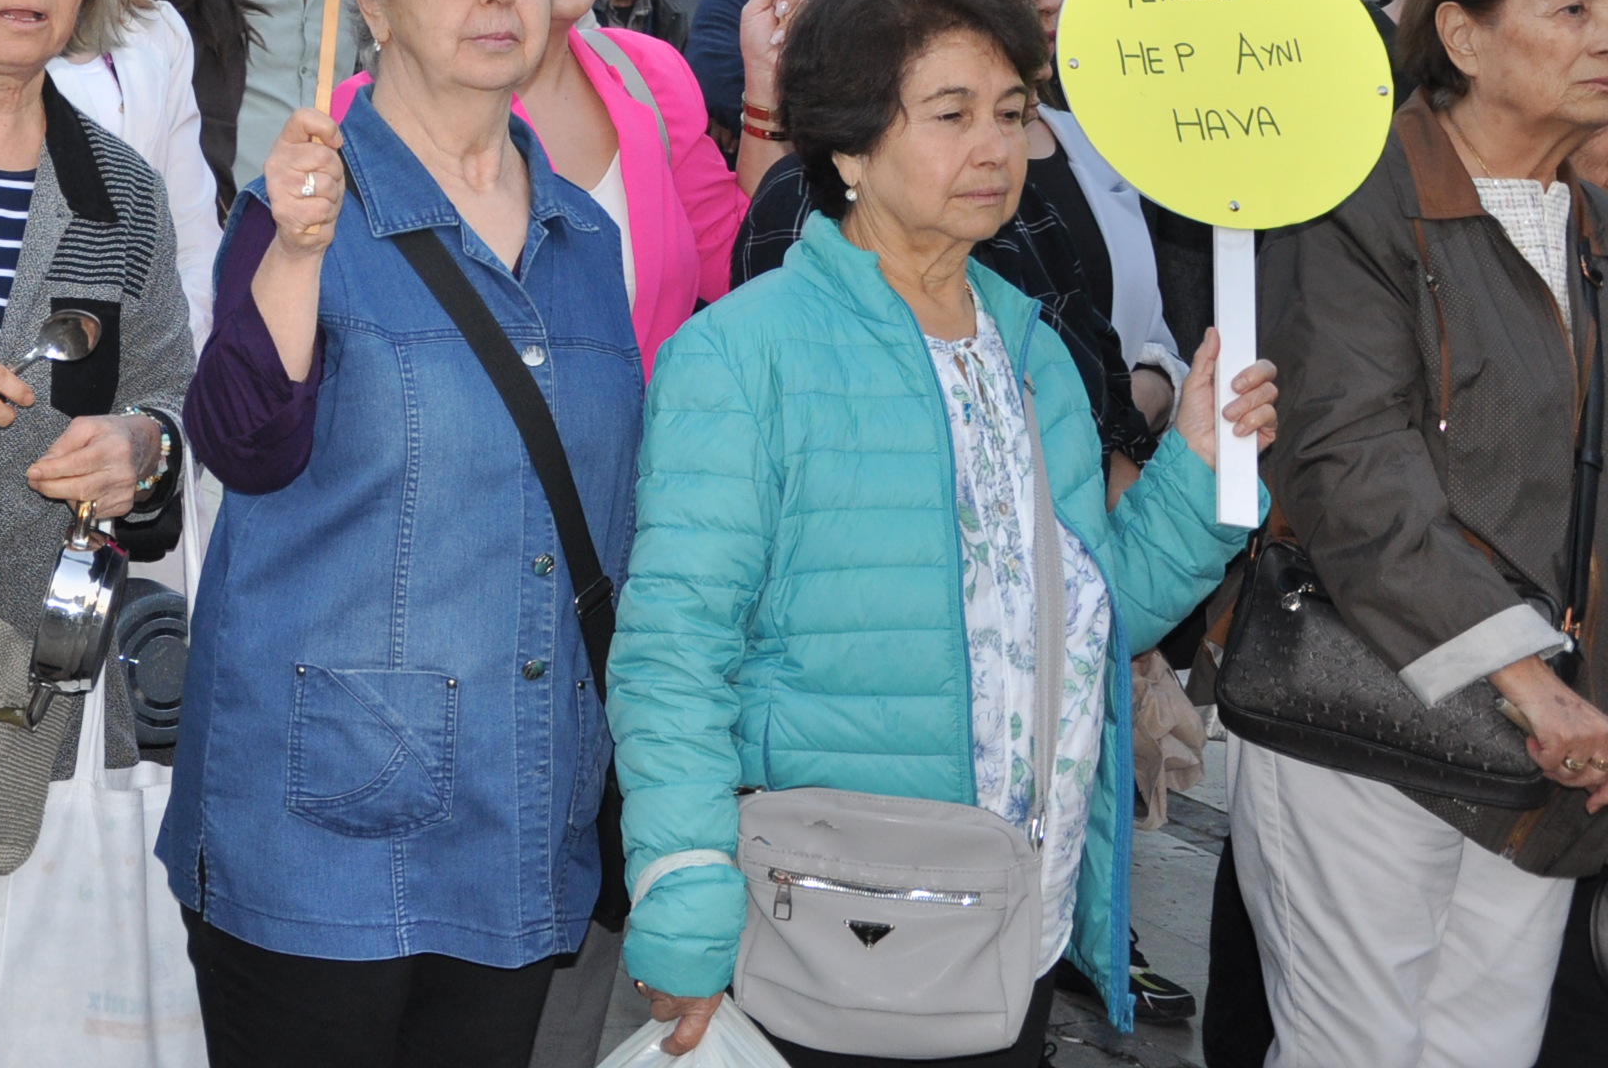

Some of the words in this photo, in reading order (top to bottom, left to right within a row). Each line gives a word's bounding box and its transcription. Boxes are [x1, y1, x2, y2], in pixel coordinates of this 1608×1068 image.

[1117, 39, 1194, 75] HEP
[1237, 33, 1301, 75] AYNI
[1173, 106, 1281, 142] HAVA
